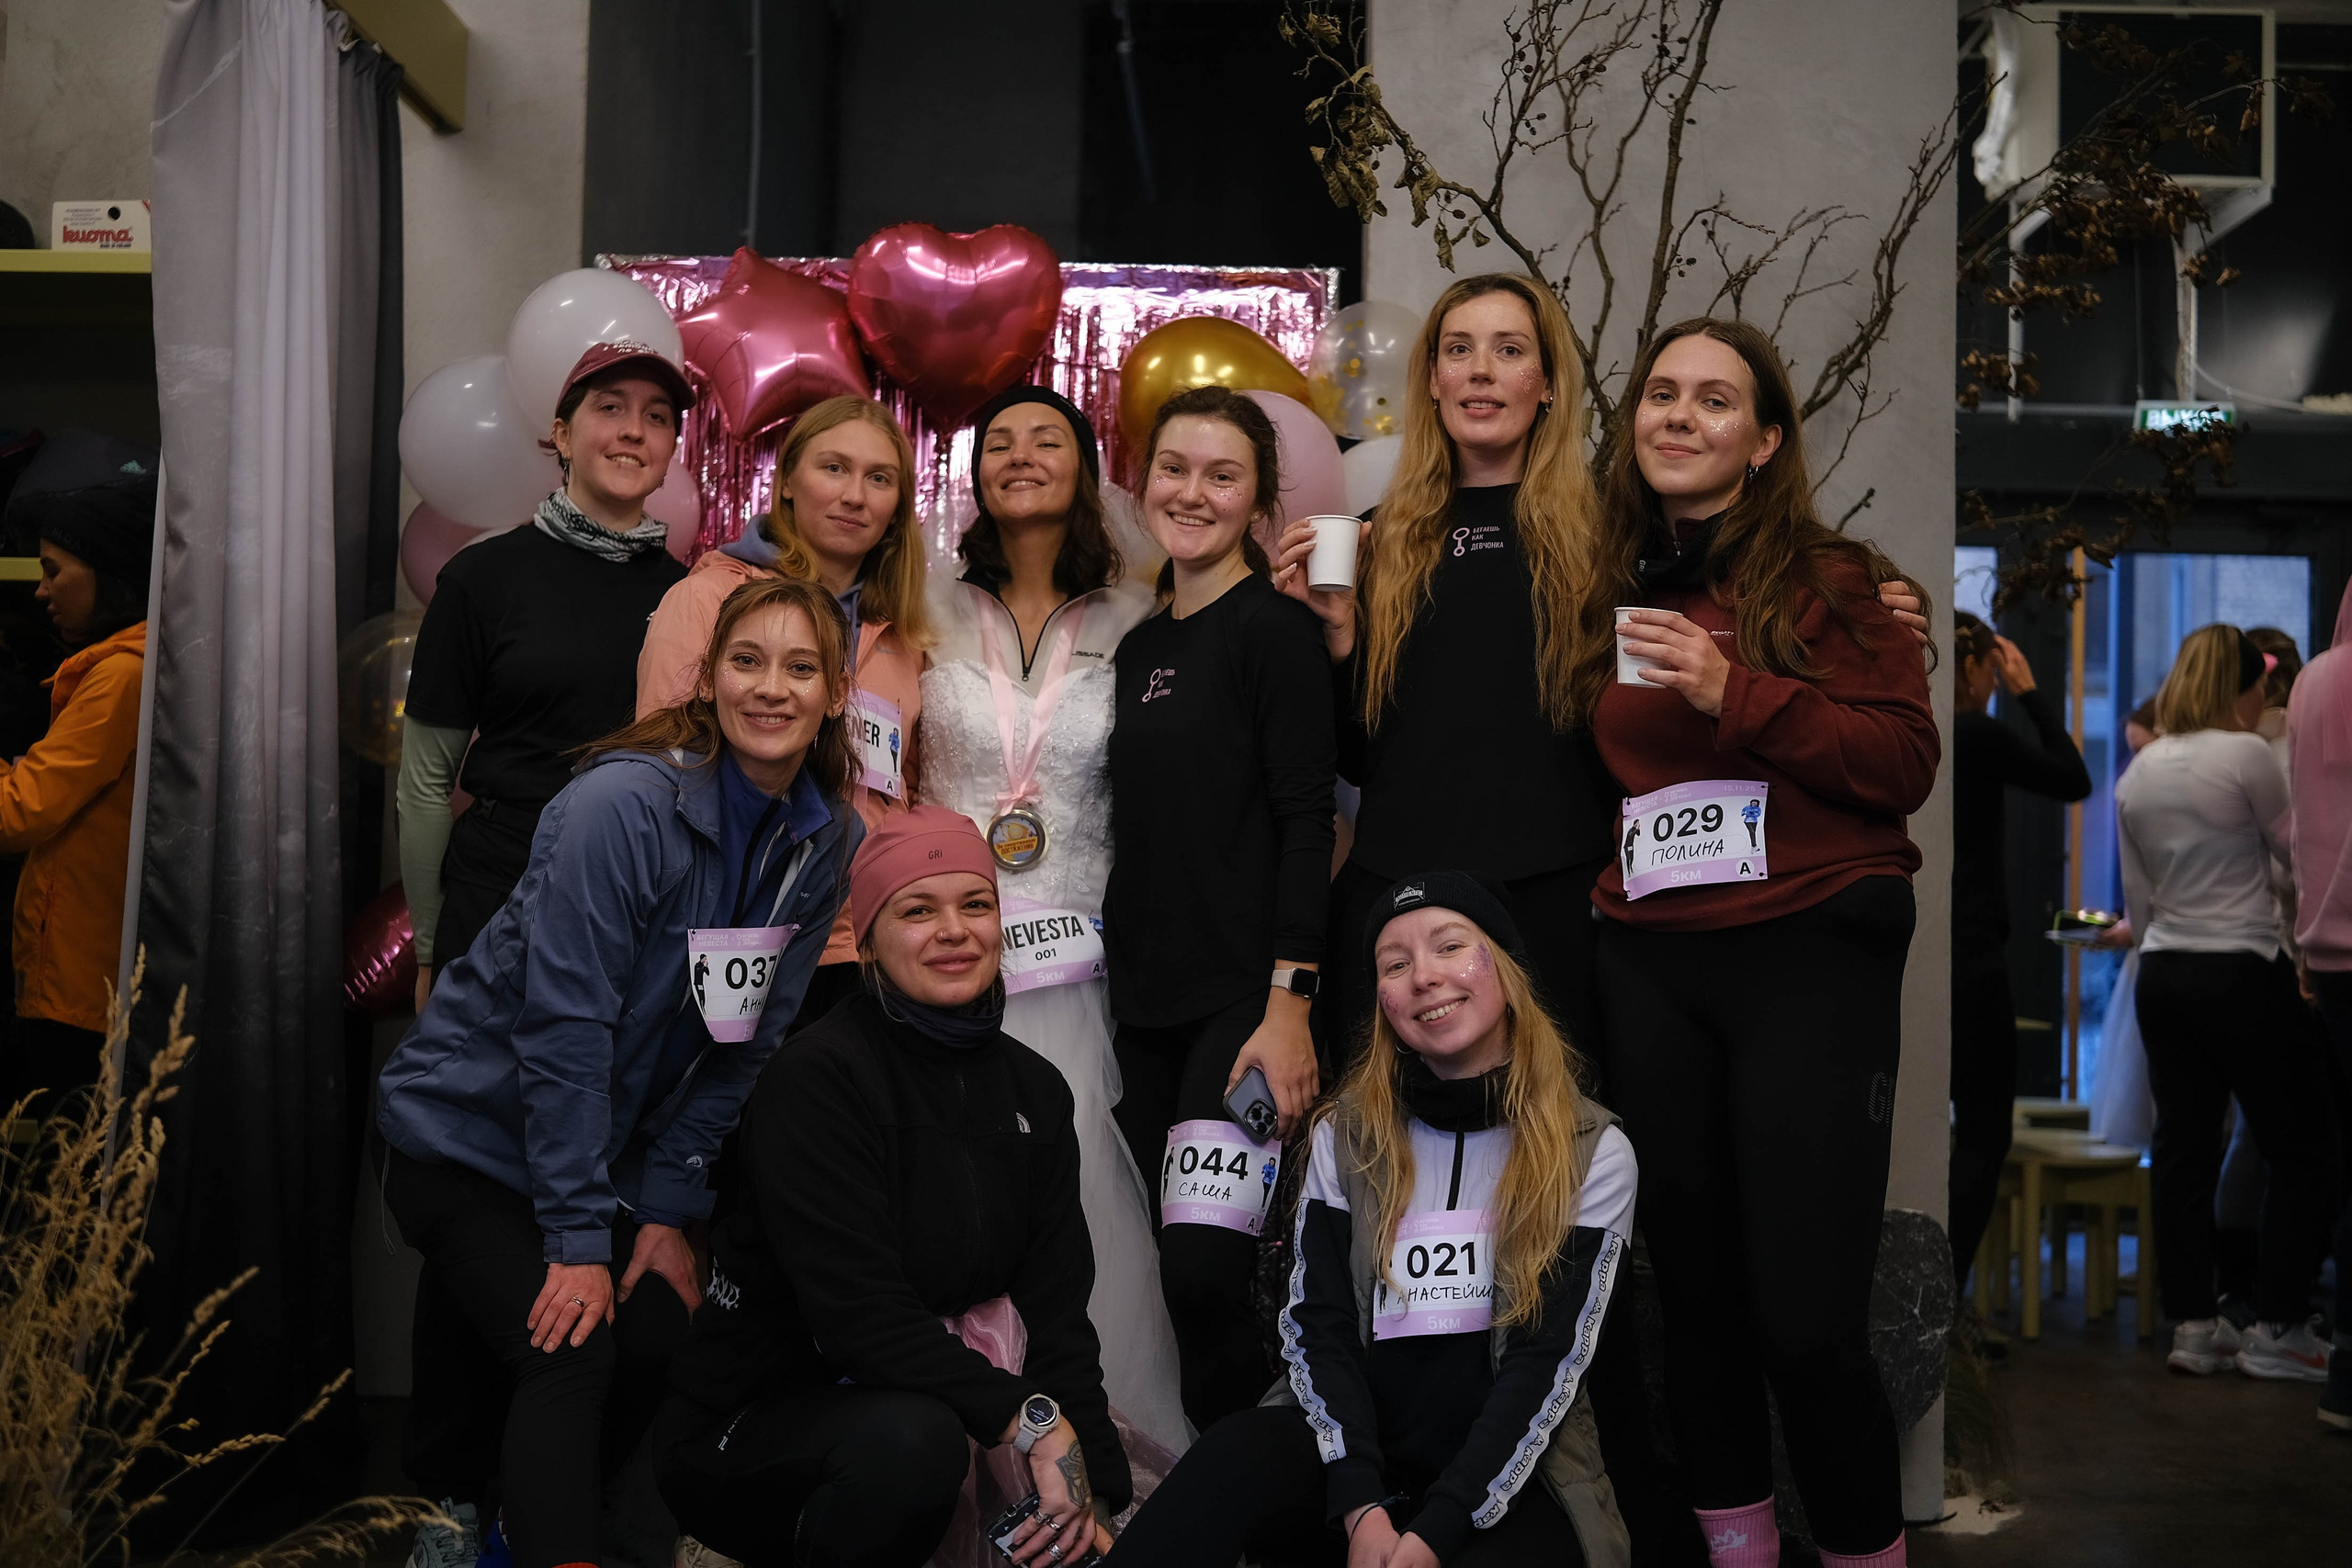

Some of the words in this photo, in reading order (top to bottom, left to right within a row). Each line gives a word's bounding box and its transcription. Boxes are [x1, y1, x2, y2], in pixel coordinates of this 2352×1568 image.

[62, 225, 133, 243] kuoma
[1471, 541, 1504, 551] ДЕВЧОНКА
[1653, 804, 1724, 842] 029
[1651, 839, 1724, 866] ПОЛИНА
[725, 954, 777, 990] 037
[1035, 948, 1057, 961] 001
[1179, 1145, 1249, 1181] 044
[1178, 1181, 1233, 1201] САША
[1407, 1241, 1476, 1279] 021
[1599, 1240, 1618, 1292] Kappa
[1574, 1315, 1596, 1365] Kappa
[1538, 1382, 1572, 1429] Kappa
[1500, 1445, 1534, 1492] Kappa
